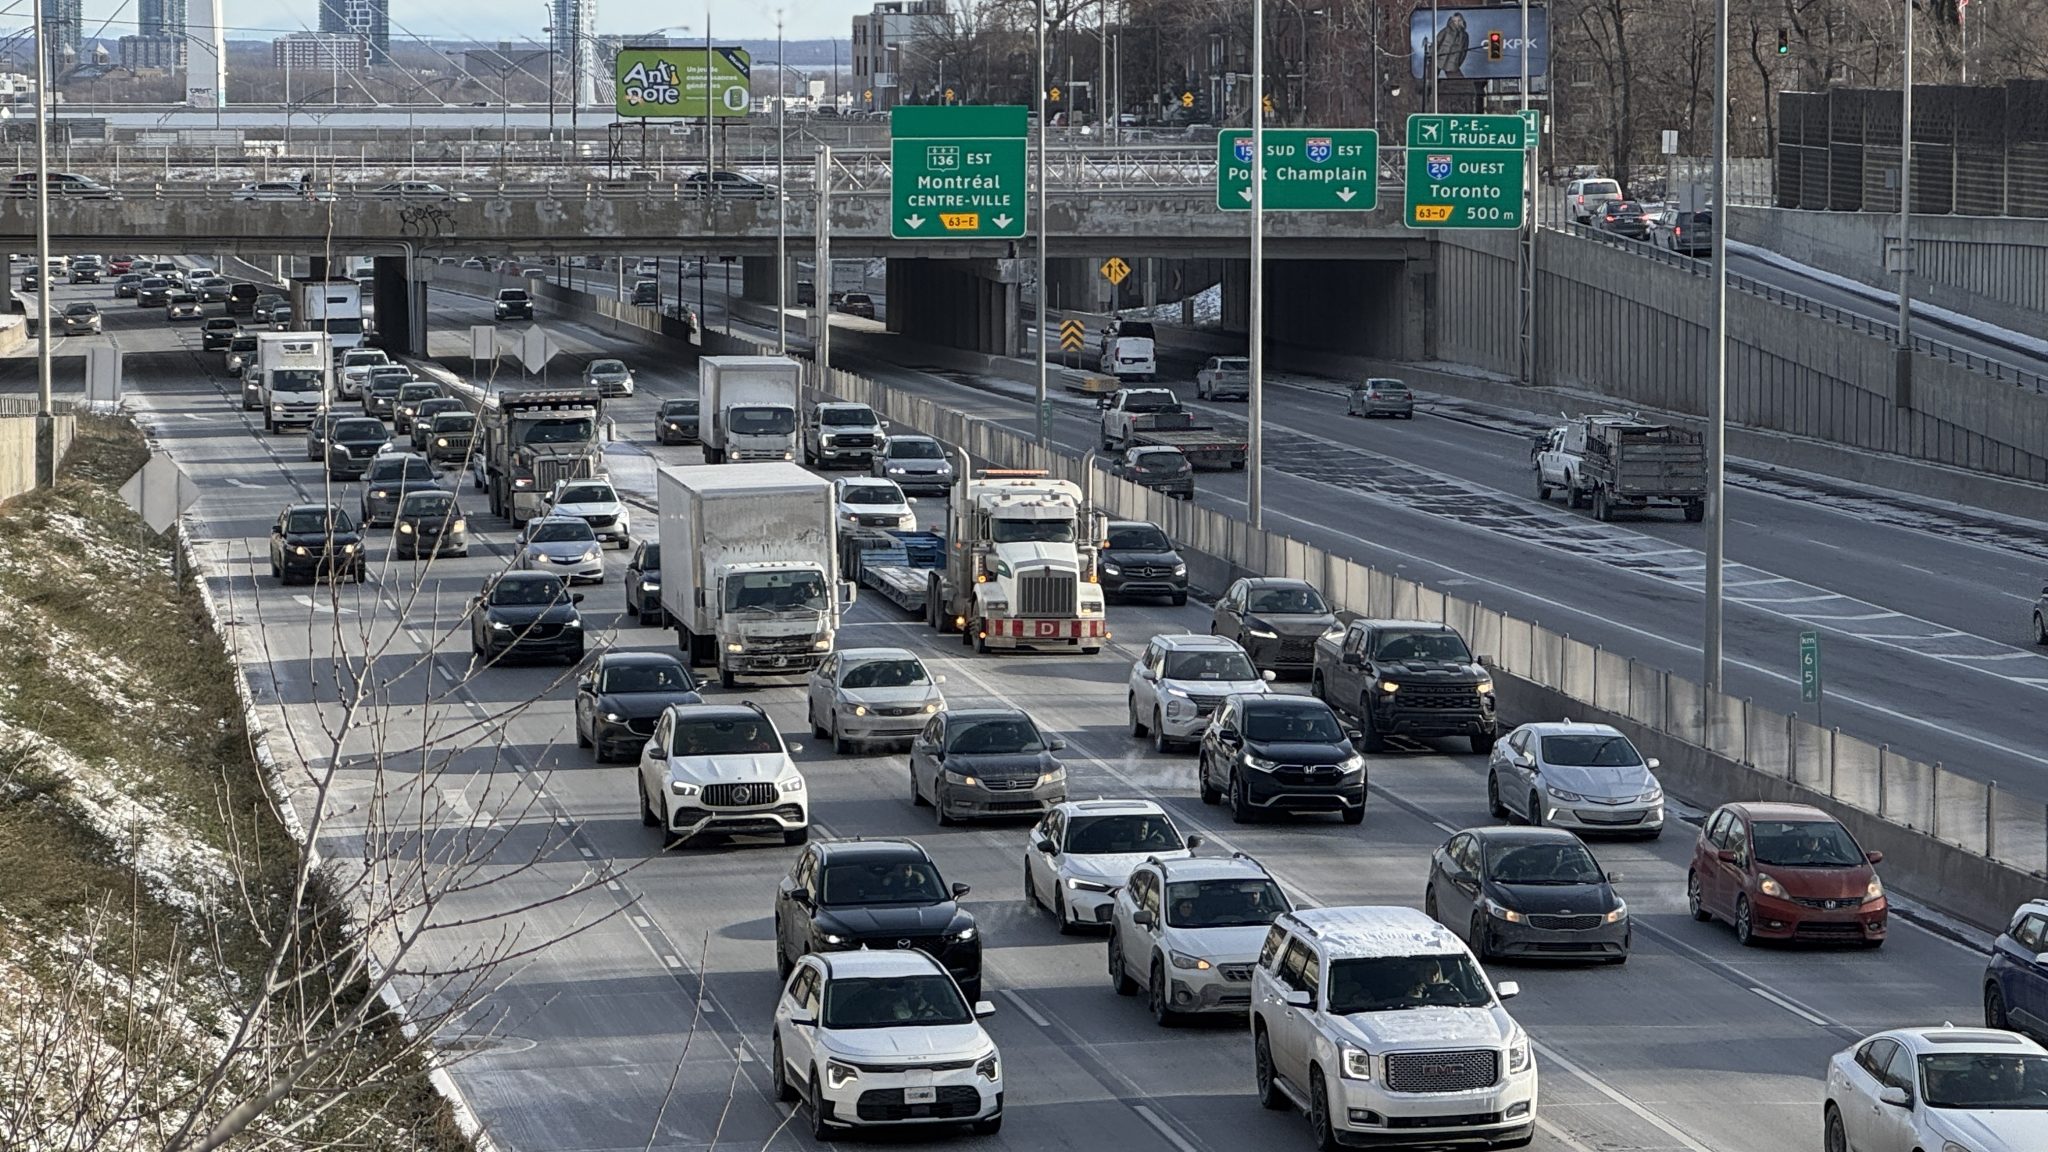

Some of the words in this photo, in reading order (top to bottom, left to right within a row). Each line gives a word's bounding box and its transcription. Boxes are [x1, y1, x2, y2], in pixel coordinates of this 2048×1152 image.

[1450, 119, 1490, 131] P.-E.-
[1450, 133, 1517, 145] TRUDEAU
[1239, 146, 1253, 156] 15
[1266, 145, 1295, 156] SUD
[1310, 146, 1328, 156] 20
[1338, 145, 1363, 156] EST
[932, 155, 955, 166] 136
[966, 153, 992, 165] EST
[1430, 163, 1449, 174] 20
[1458, 162, 1505, 174] OUEST
[1228, 167, 1268, 181] Pot
[1276, 166, 1368, 184] Champlain
[917, 174, 1001, 190] Montréal
[1429, 184, 1501, 199] Toronto
[907, 194, 1012, 207] CENTRE-VILLE
[1466, 206, 1500, 220] 500
[1503, 211, 1514, 220] m
[948, 216, 975, 227] 63-E
[1040, 622, 1054, 635] D
[1801, 636, 1816, 645] km
[1422, 1063, 1465, 1075] GMC
